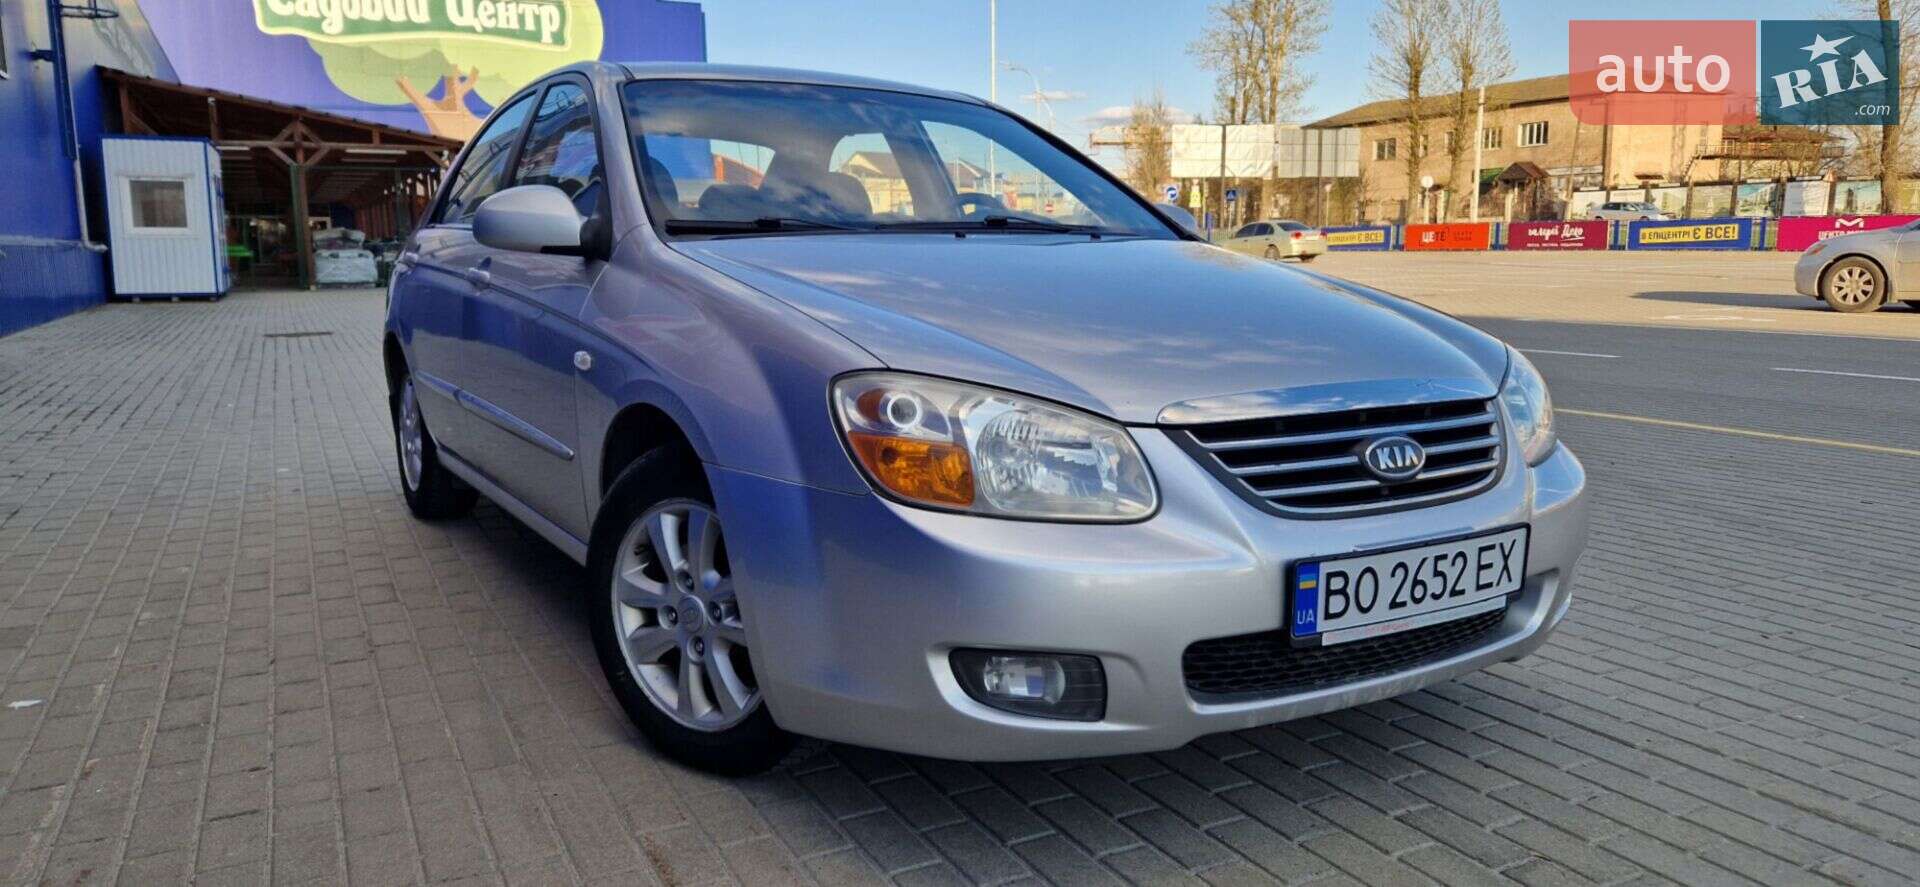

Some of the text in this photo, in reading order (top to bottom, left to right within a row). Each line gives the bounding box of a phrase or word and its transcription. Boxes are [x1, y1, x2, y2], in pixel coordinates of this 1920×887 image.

[446, 0, 561, 43] Центр
[1705, 226, 1736, 239] ВСЕ!
[1376, 446, 1419, 470] KIA
[1324, 539, 1517, 621] BO 2652 EX
[1297, 609, 1315, 625] UA
